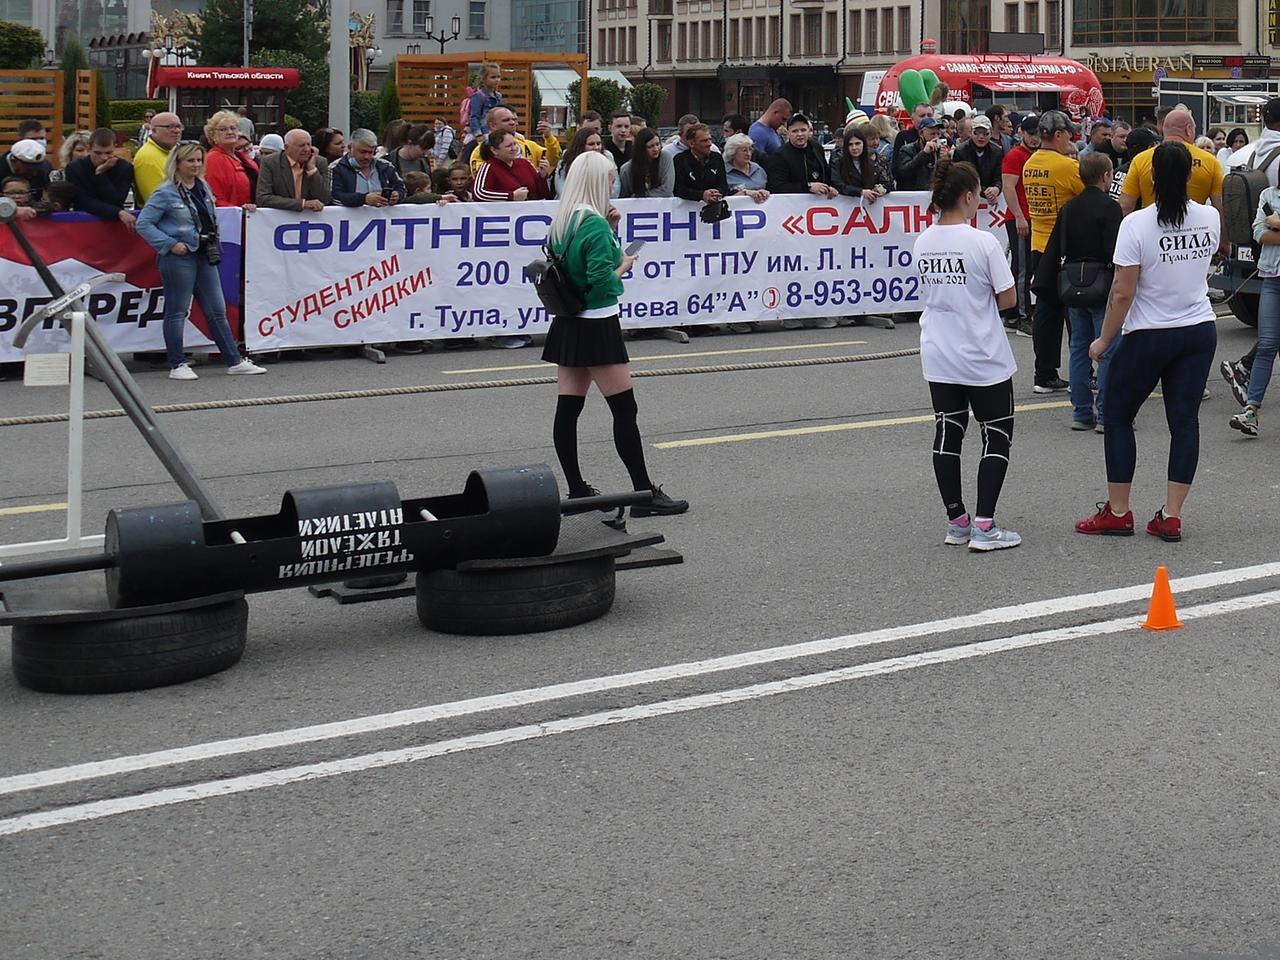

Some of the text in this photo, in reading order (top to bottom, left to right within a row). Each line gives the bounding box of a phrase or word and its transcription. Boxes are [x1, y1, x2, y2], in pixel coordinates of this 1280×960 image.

[187, 71, 284, 80] Книги Тульской области
[1087, 56, 1194, 73] RESTAURAN
[1023, 169, 1049, 179] СУДЬЯ
[1158, 231, 1212, 252] СИЛА
[456, 260, 510, 287] 200
[643, 260, 676, 280] от
[683, 250, 759, 277] ТГПУ
[767, 254, 809, 273] им.
[816, 247, 841, 271] Л.
[850, 246, 874, 269] Н.
[917, 258, 967, 275] СИЛА
[1160, 252, 1189, 265] Тулы
[945, 275, 967, 285] 2021
[257, 254, 401, 337] СТУДЕНТАМ
[333, 266, 434, 329] СКИДКИ!
[409, 310, 425, 329] г.
[435, 305, 508, 333] Тула,
[786, 275, 920, 308] 8-953-962
[298, 507, 404, 537] АТЛЕТИКИ
[301, 529, 403, 560] ТЯЖЁЛОЙ
[279, 548, 415, 579] ФЕДЕРАЦИЯ
